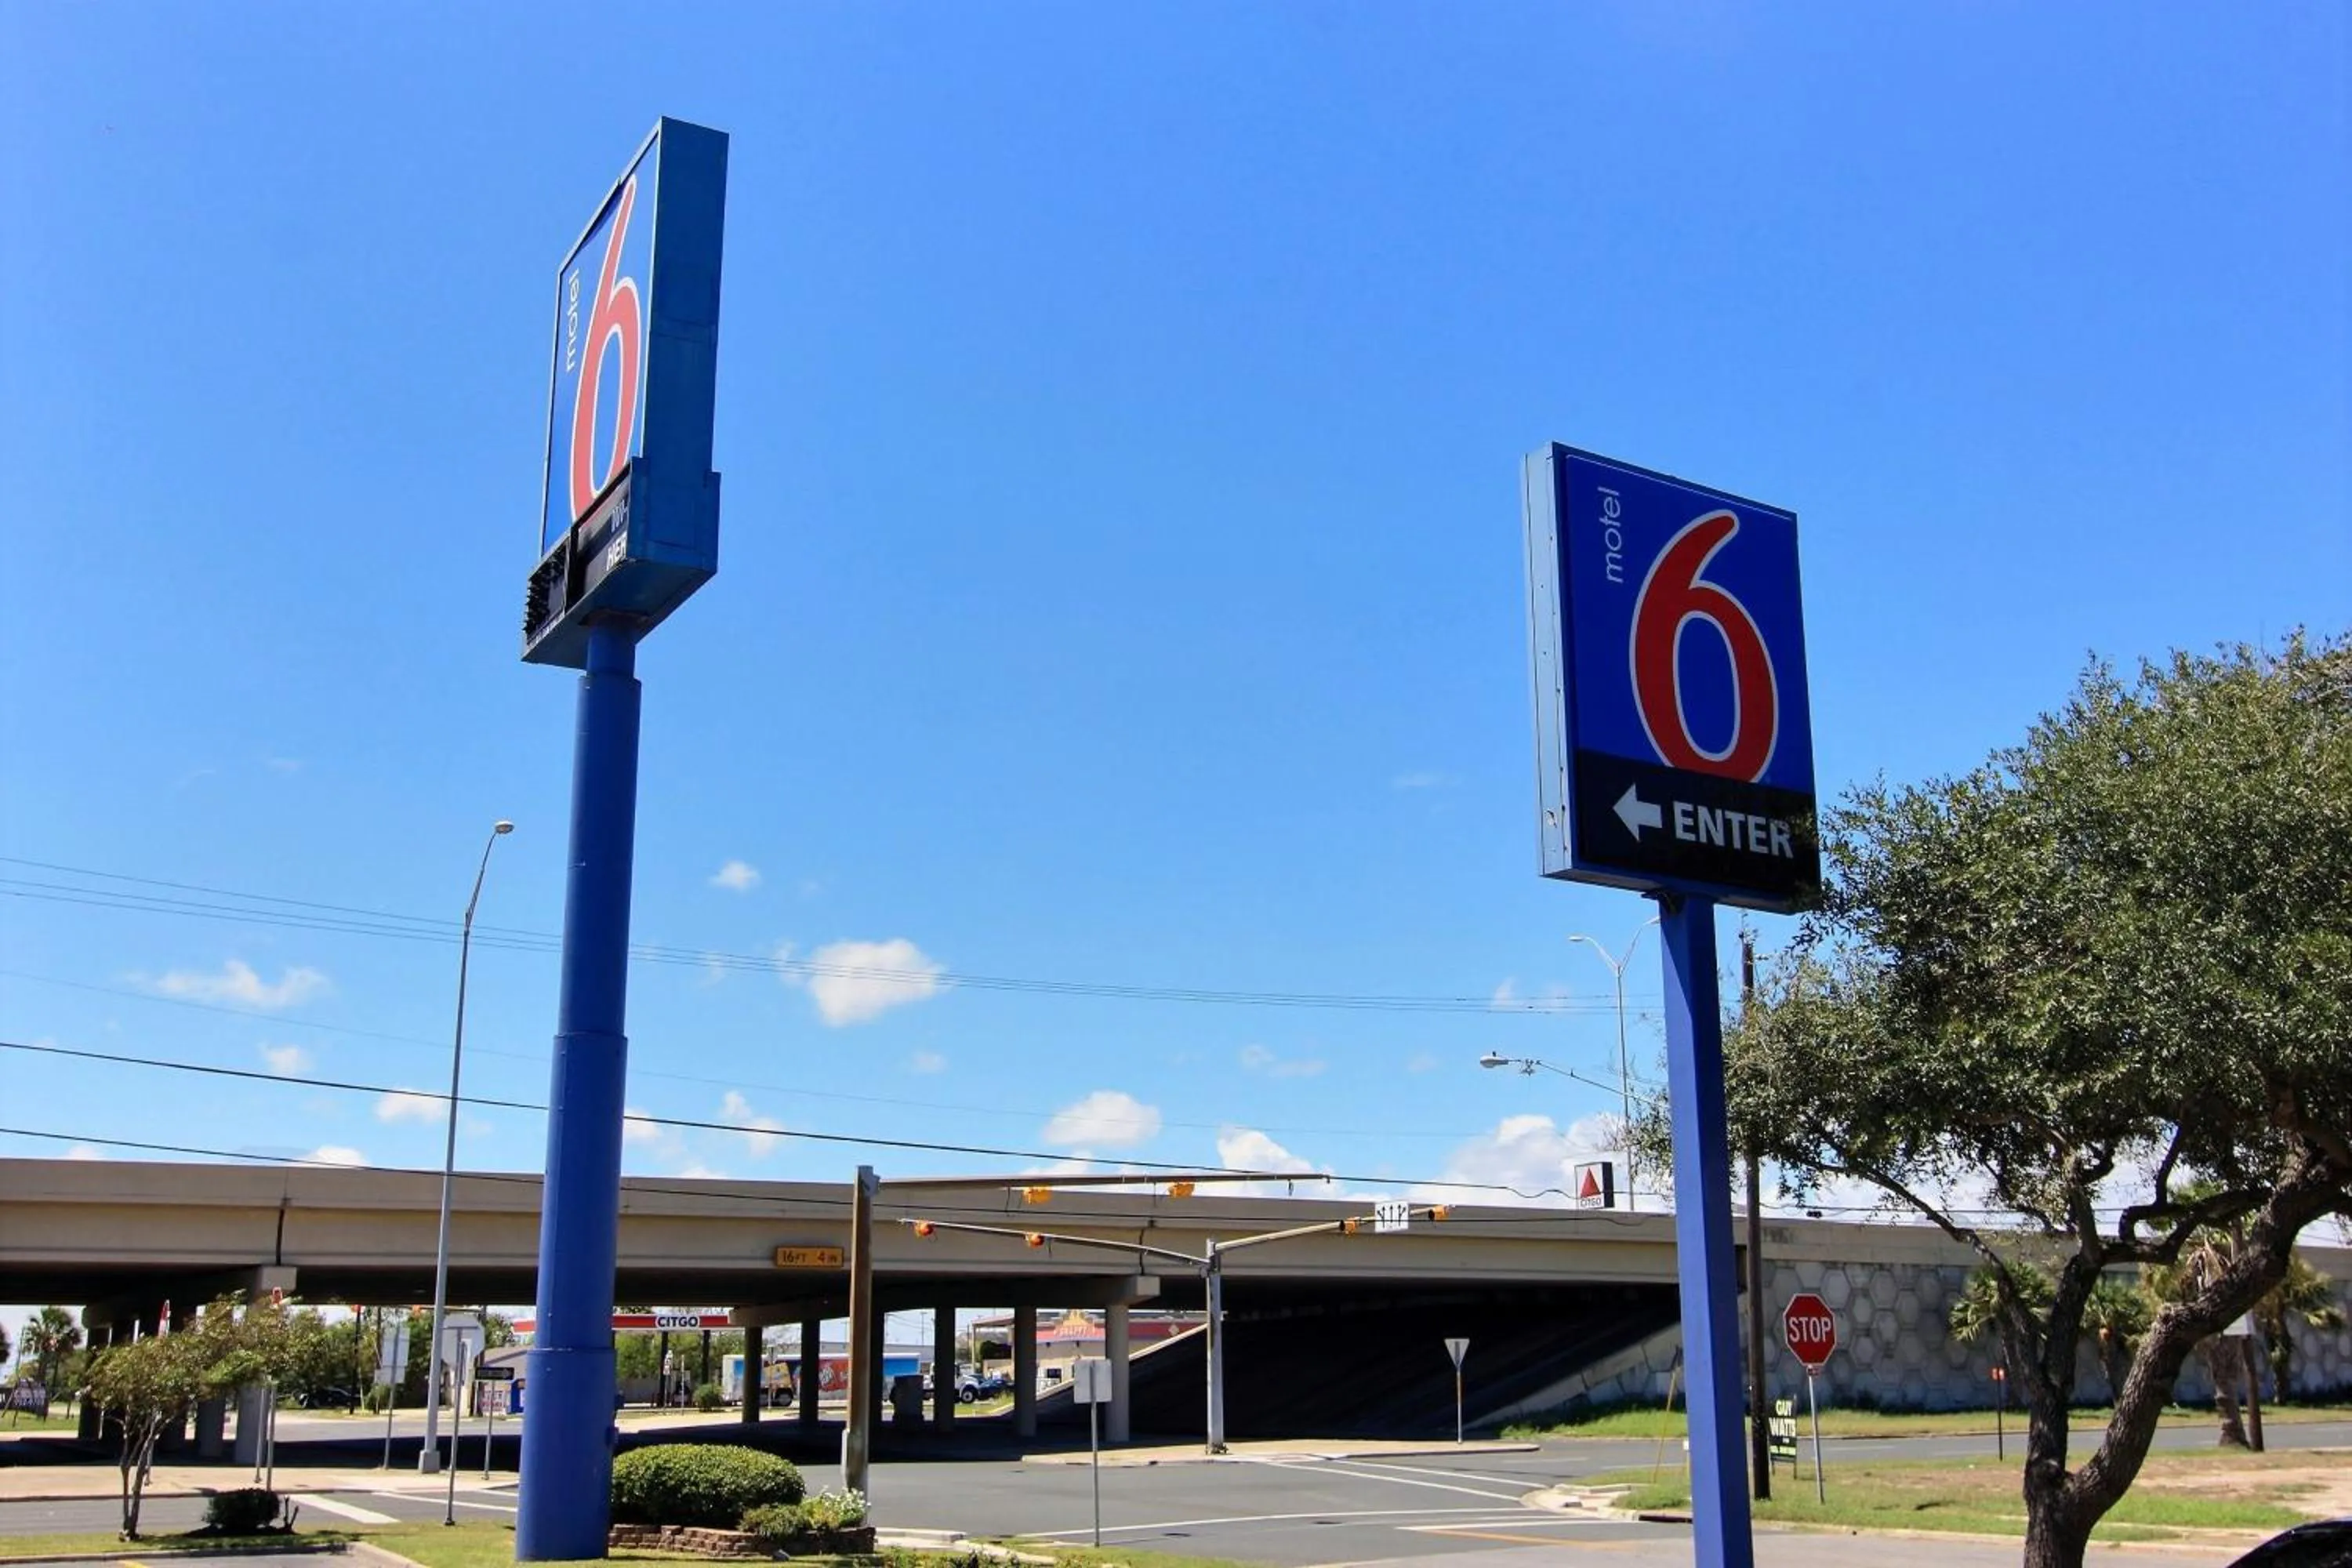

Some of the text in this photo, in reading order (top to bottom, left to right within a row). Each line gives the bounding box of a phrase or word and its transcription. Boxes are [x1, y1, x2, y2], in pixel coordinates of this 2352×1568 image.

[565, 267, 579, 372] motel
[570, 173, 641, 523] 6
[1597, 486, 1624, 584] motel
[1629, 509, 1779, 783] 6
[1672, 800, 1794, 858] ENTER
[658, 1316, 698, 1327] CITGO
[1789, 1317, 1831, 1343] STOP
[1769, 1417, 1796, 1437] WATTS
